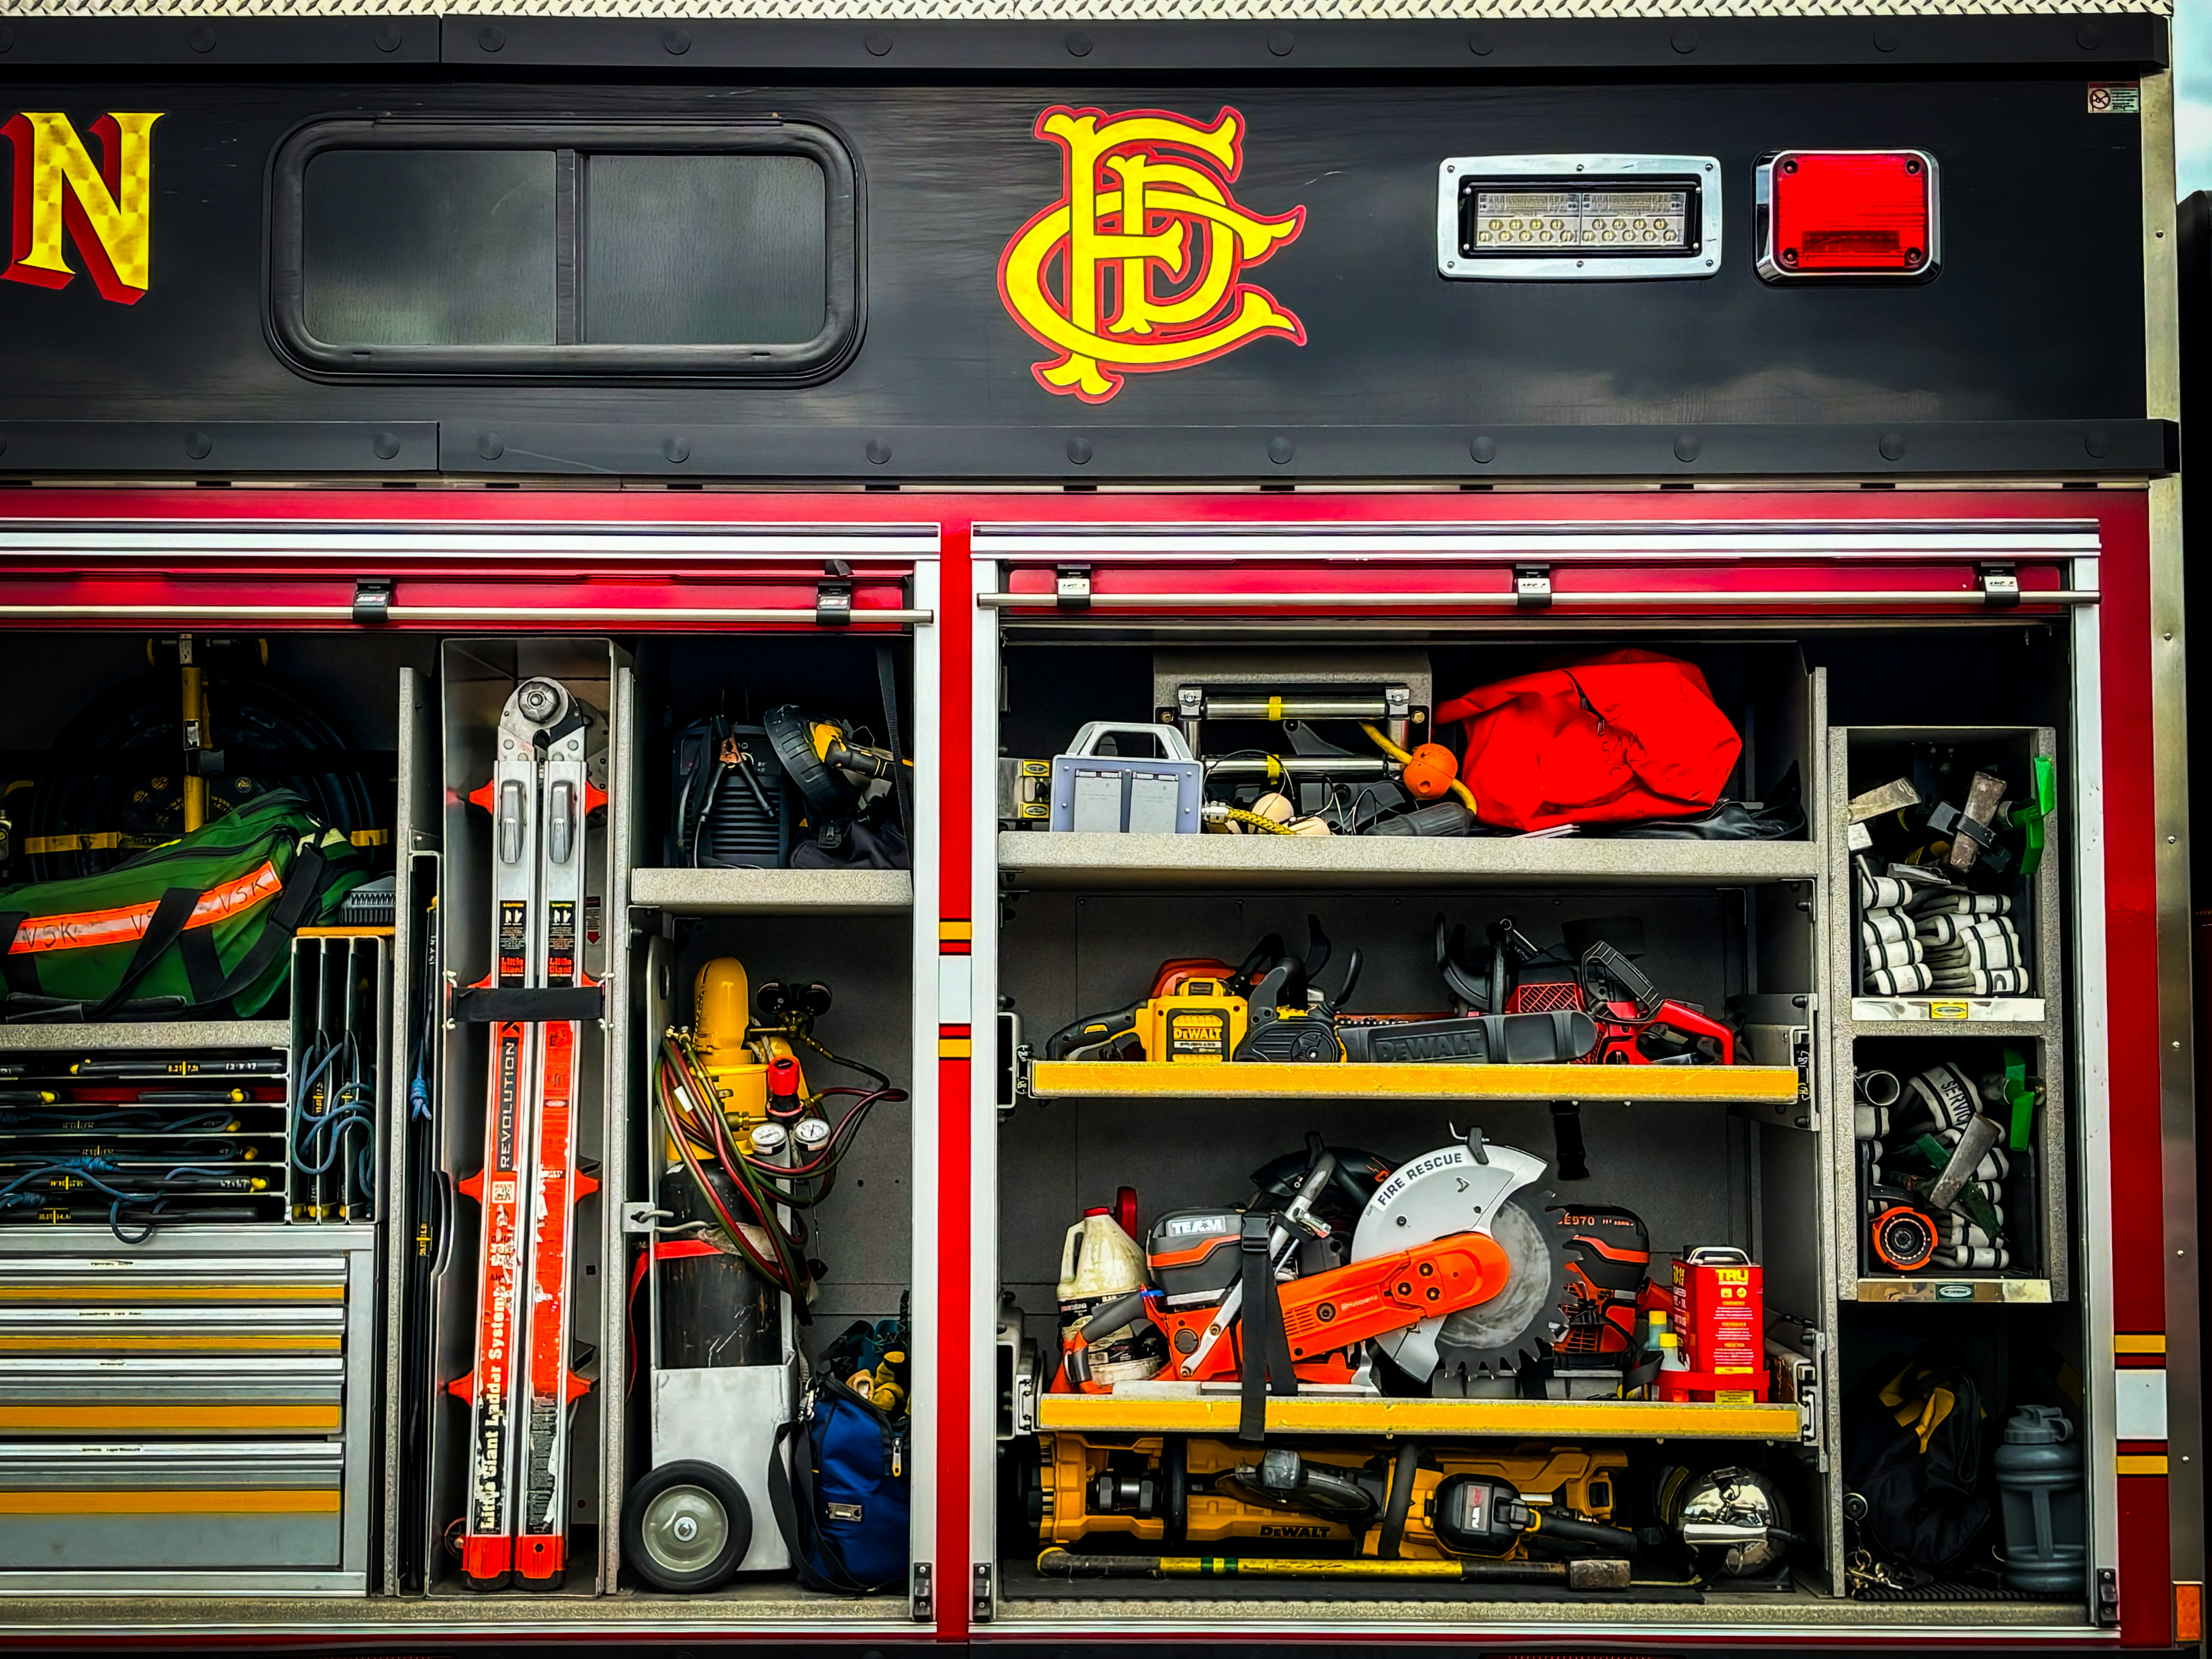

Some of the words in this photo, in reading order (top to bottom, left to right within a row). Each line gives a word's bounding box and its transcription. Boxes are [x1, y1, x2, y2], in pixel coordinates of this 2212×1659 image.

[216, 874, 270, 912] VSK
[23, 920, 78, 949] VSK
[1173, 1028, 1222, 1040] DEWALT
[1375, 1033, 1481, 1062] DEWALT
[499, 1042, 516, 1169] REVOLUTION
[1377, 1177, 1405, 1206] FIRE
[1406, 1153, 1463, 1180] RESCUE
[1557, 1212, 1595, 1226] E970
[485, 1366, 501, 1426] Ladder
[1260, 1525, 1331, 1538] DEWALT
